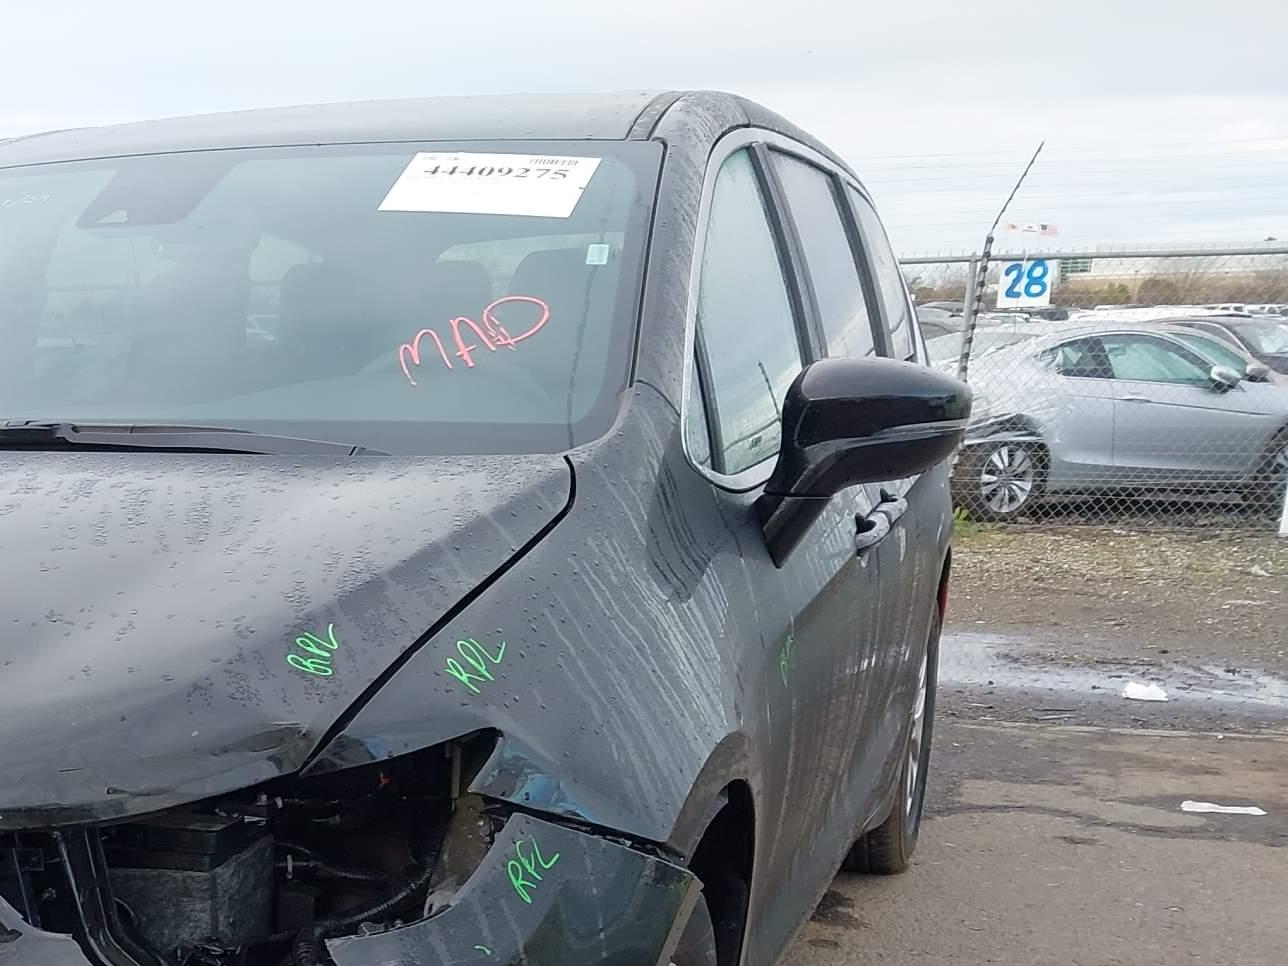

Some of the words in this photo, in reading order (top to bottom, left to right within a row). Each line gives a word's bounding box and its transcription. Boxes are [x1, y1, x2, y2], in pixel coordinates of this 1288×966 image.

[423, 165, 570, 180] 44409275
[1005, 259, 1049, 298] 28
[445, 638, 506, 694] RPL
